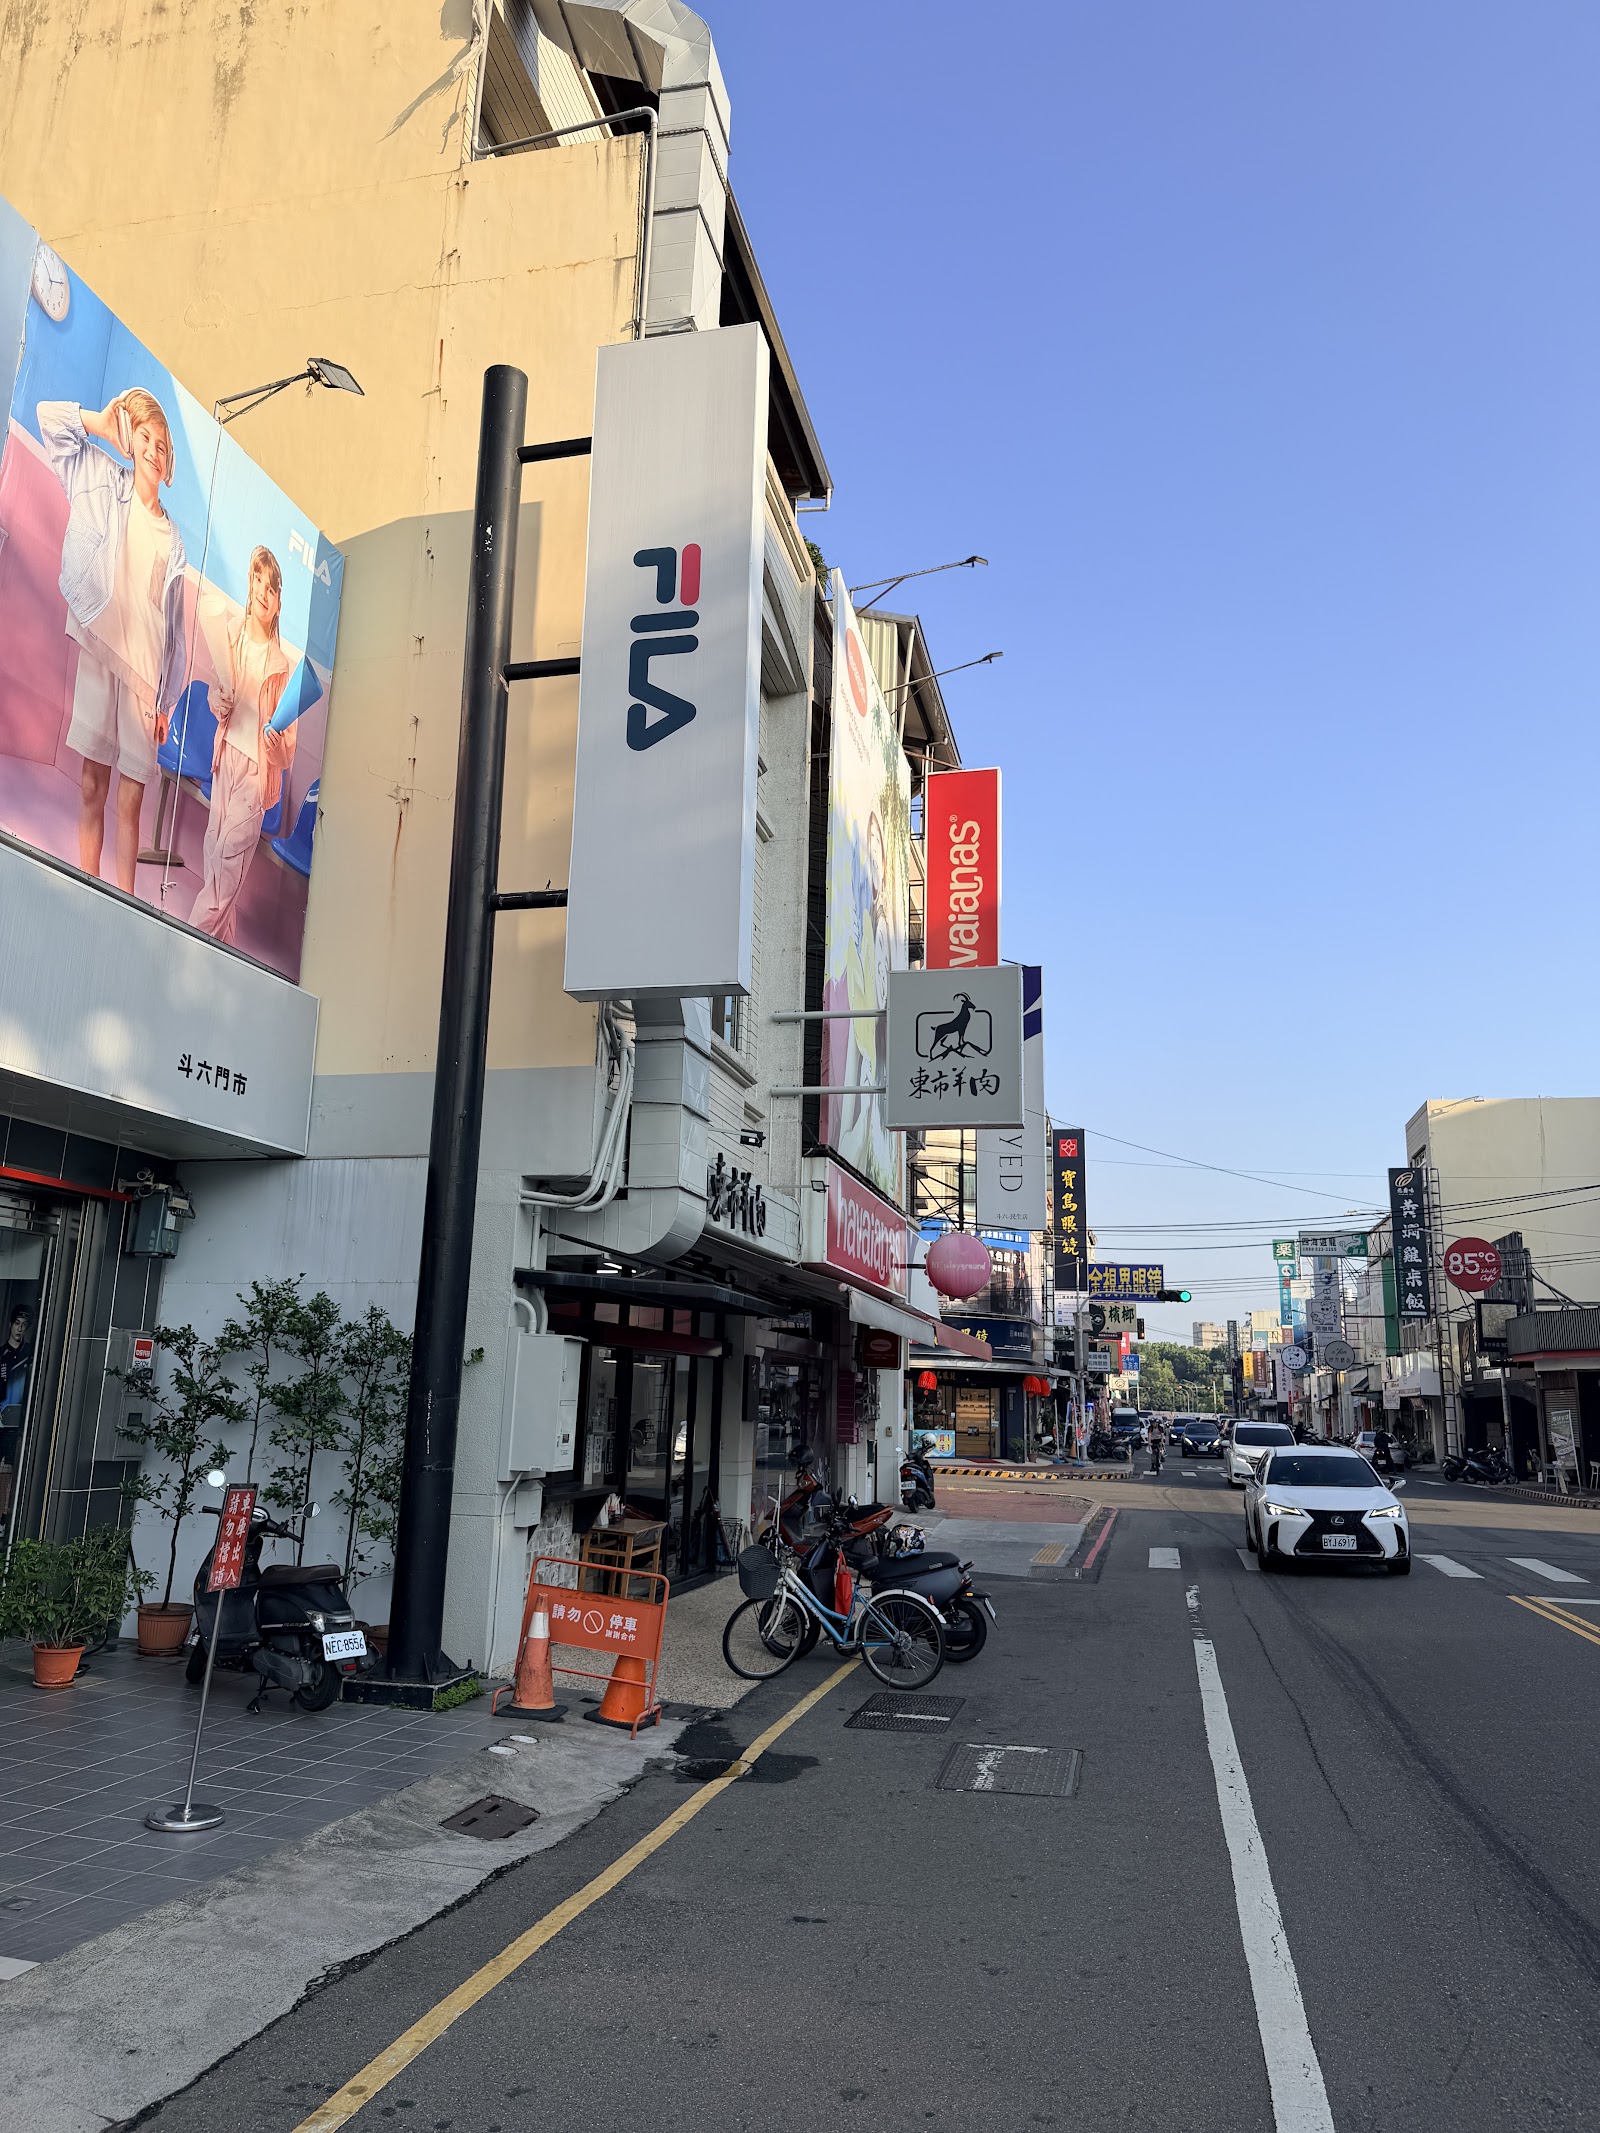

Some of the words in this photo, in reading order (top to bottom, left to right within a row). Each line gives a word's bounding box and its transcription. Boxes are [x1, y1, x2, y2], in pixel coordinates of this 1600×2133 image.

[289, 528, 331, 586] FILA
[626, 543, 701, 751] FILA
[949, 820, 982, 969] vaianas
[178, 1053, 247, 1096] 斗六門市
[908, 1066, 1000, 1100] 東市羊肉
[836, 1175, 901, 1283] havaianas
[1061, 1169, 1080, 1256] 寶島眼鏡
[1088, 1266, 1162, 1299] 金視界眼鏡
[225, 1492, 251, 1583] 車庫出入
[551, 1603, 582, 1623] 請勿
[609, 1613, 638, 1632] 停車
[605, 1629, 636, 1642] 謝謝合作
